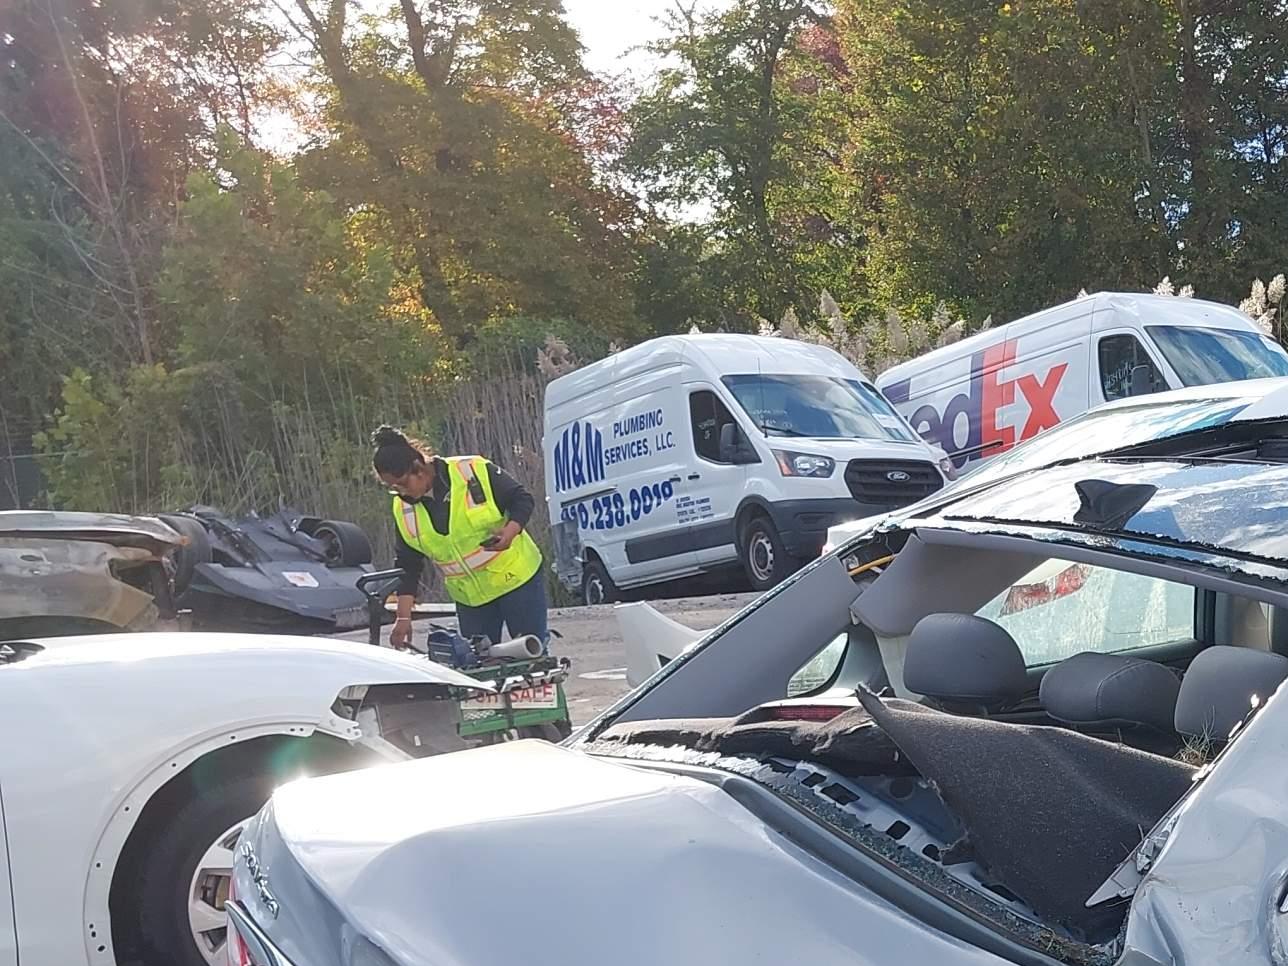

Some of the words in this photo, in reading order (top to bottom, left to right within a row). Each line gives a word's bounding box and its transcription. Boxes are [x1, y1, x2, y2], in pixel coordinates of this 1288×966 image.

[613, 408, 663, 438] PLUMBING
[882, 339, 1068, 470] edEx
[554, 420, 606, 493] M&M
[604, 438, 652, 466] SERVICES,
[655, 431, 676, 451] LLC.
